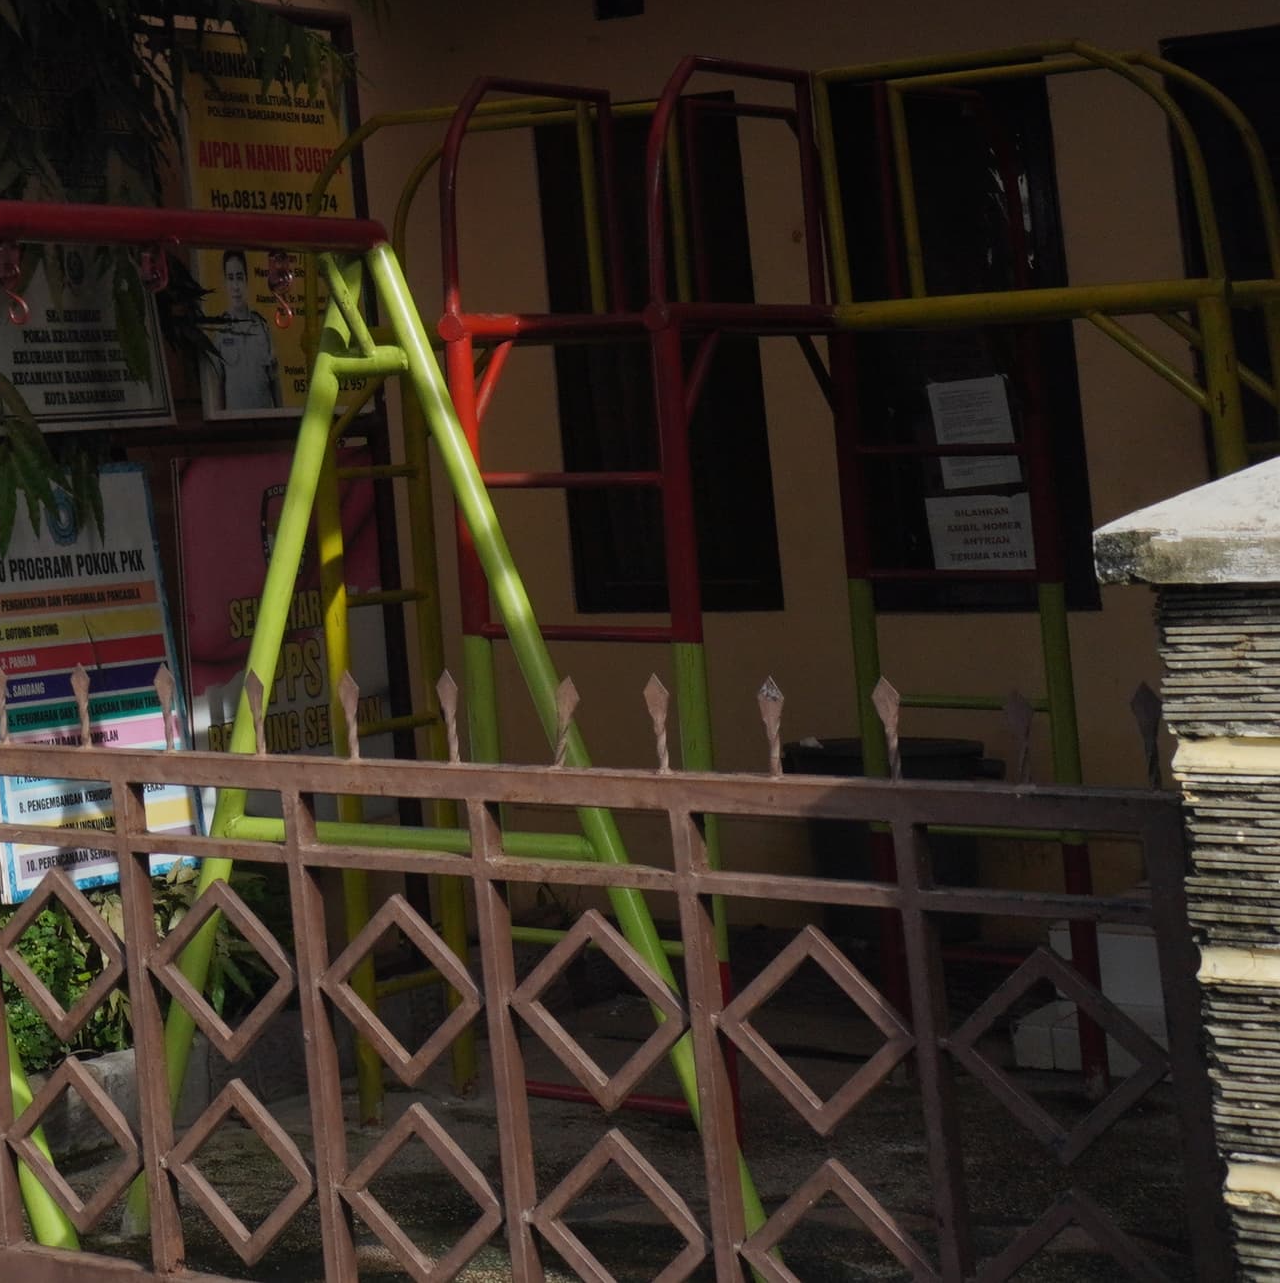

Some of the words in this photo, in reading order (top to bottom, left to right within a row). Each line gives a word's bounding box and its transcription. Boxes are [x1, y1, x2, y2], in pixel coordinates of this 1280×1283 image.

[199, 139, 241, 168] AIPDA
[245, 143, 291, 172] NANNI
[271, 191, 303, 211] 4970
[306, 193, 338, 212] 574
[8, 554, 74, 583] PROGRAM
[76, 550, 119, 577] POKOK
[120, 548, 146, 573] PKK
[48, 595, 62, 608] DAN
[5, 625, 32, 640] GOTONG
[33, 623, 59, 637] ROYONG
[9, 653, 37, 669] PANGAN
[13, 681, 46, 698] SANDANG
[19, 801, 27, 814] 8.
[27, 791, 84, 814] PENGEMBANGAN
[84, 787, 113, 803] KEHIDUP
[76, 816, 115, 830] LINGKUNGA
[26, 857, 37, 873] 10.
[38, 849, 89, 871] PERENCANAAN
